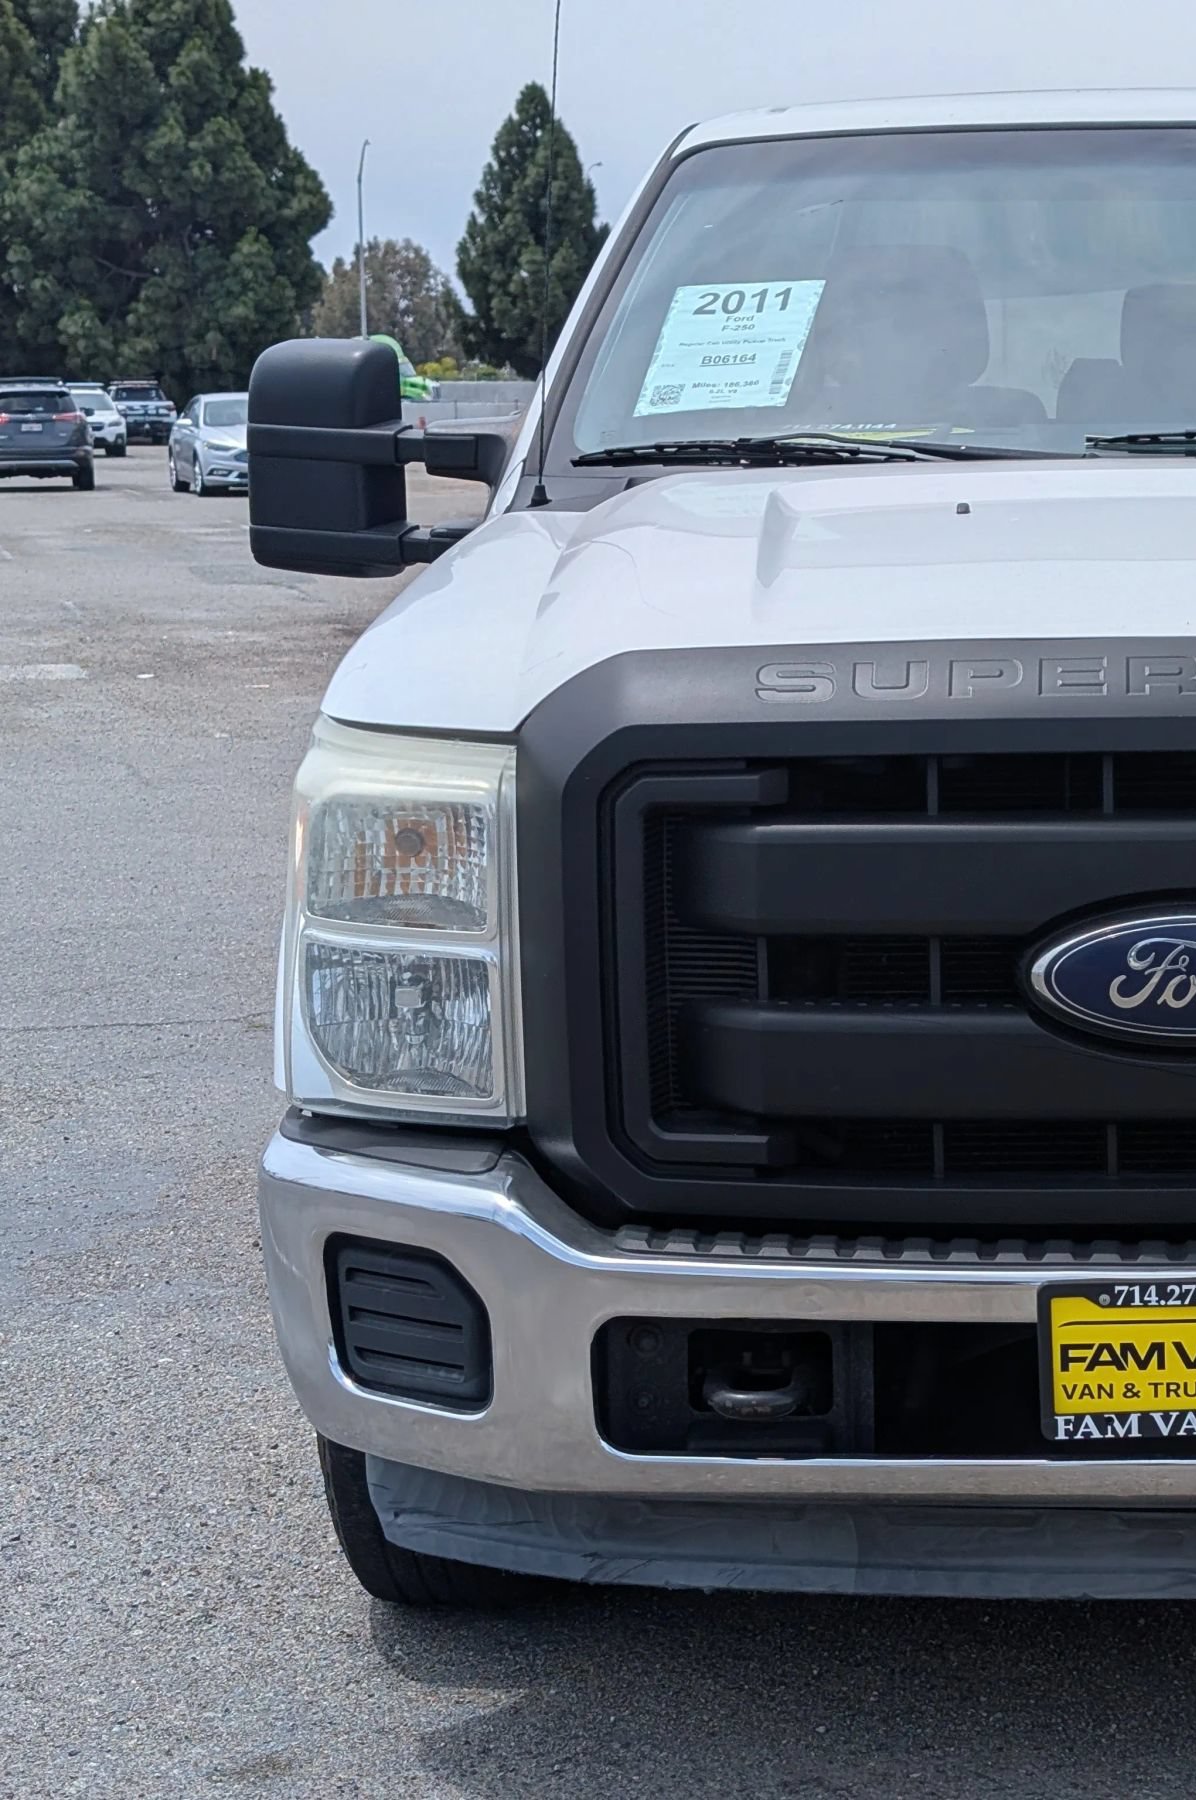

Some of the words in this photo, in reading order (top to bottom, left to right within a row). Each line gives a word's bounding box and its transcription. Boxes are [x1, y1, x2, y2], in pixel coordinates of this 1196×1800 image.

[692, 287, 793, 315] 2011
[721, 324, 756, 332] F-250
[725, 315, 755, 323] Ford
[700, 353, 757, 366] B06164
[1060, 1341, 1166, 1372] FAM
[1062, 1383, 1114, 1400] VAN
[1122, 1382, 1141, 1399] &
[1054, 1413, 1142, 1440] FAM
